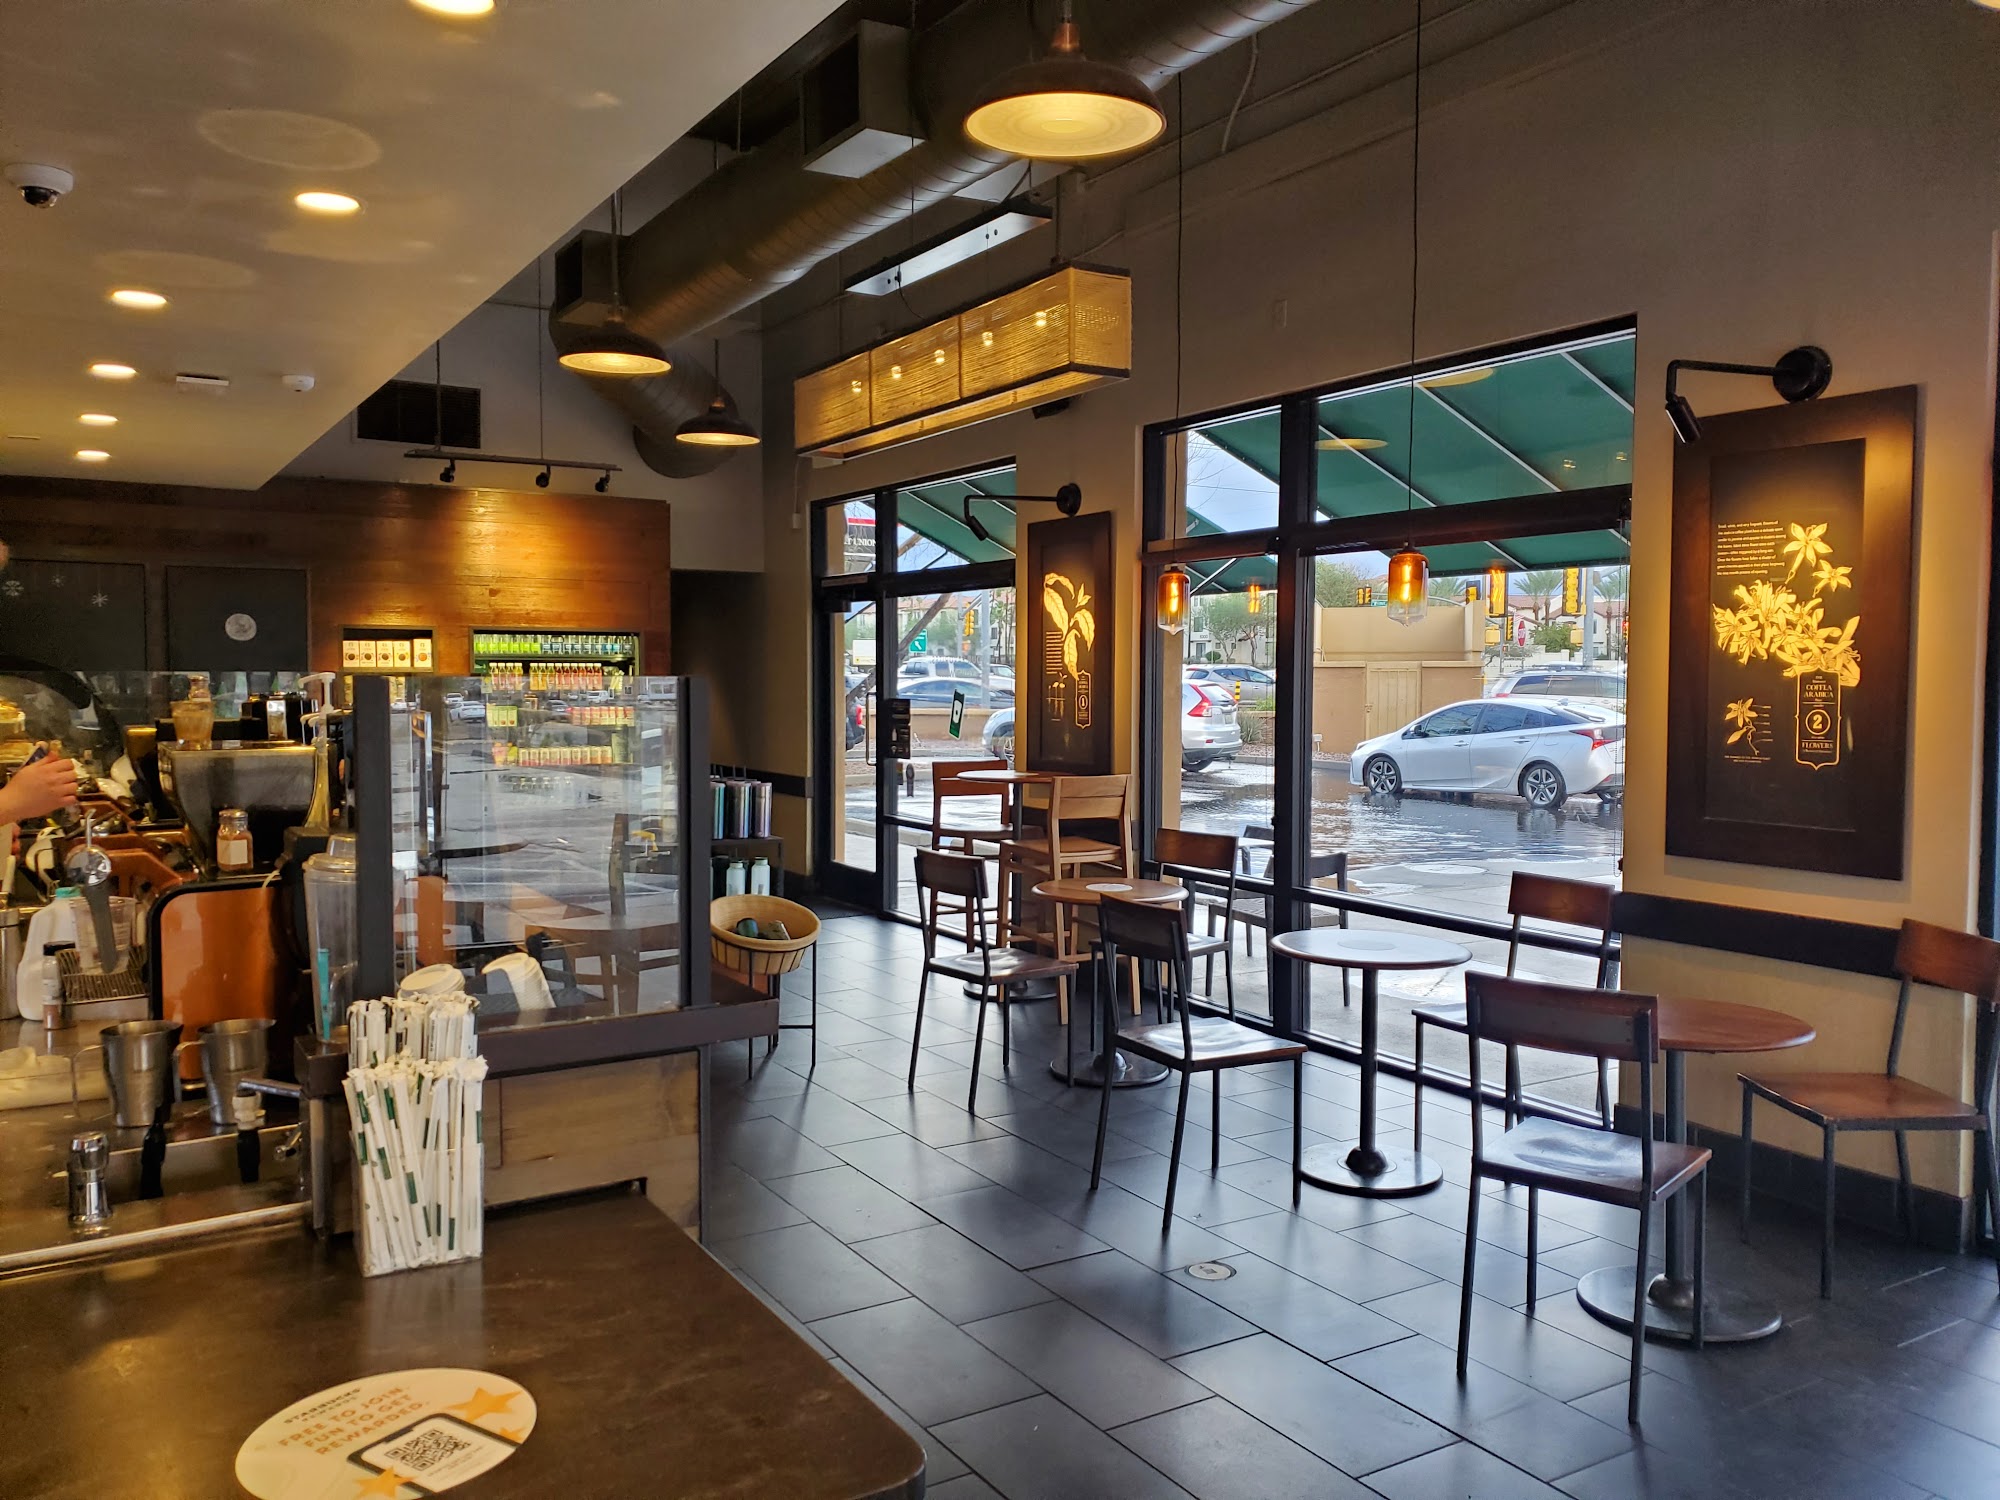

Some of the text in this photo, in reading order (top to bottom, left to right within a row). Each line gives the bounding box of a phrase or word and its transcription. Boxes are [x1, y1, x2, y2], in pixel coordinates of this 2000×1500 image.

[1812, 714, 1823, 729] 2
[284, 1387, 360, 1424] STARBUCKS
[303, 1394, 412, 1448] FUN TO GET
[278, 1422, 326, 1447] FREE
[328, 1409, 357, 1422] TO
